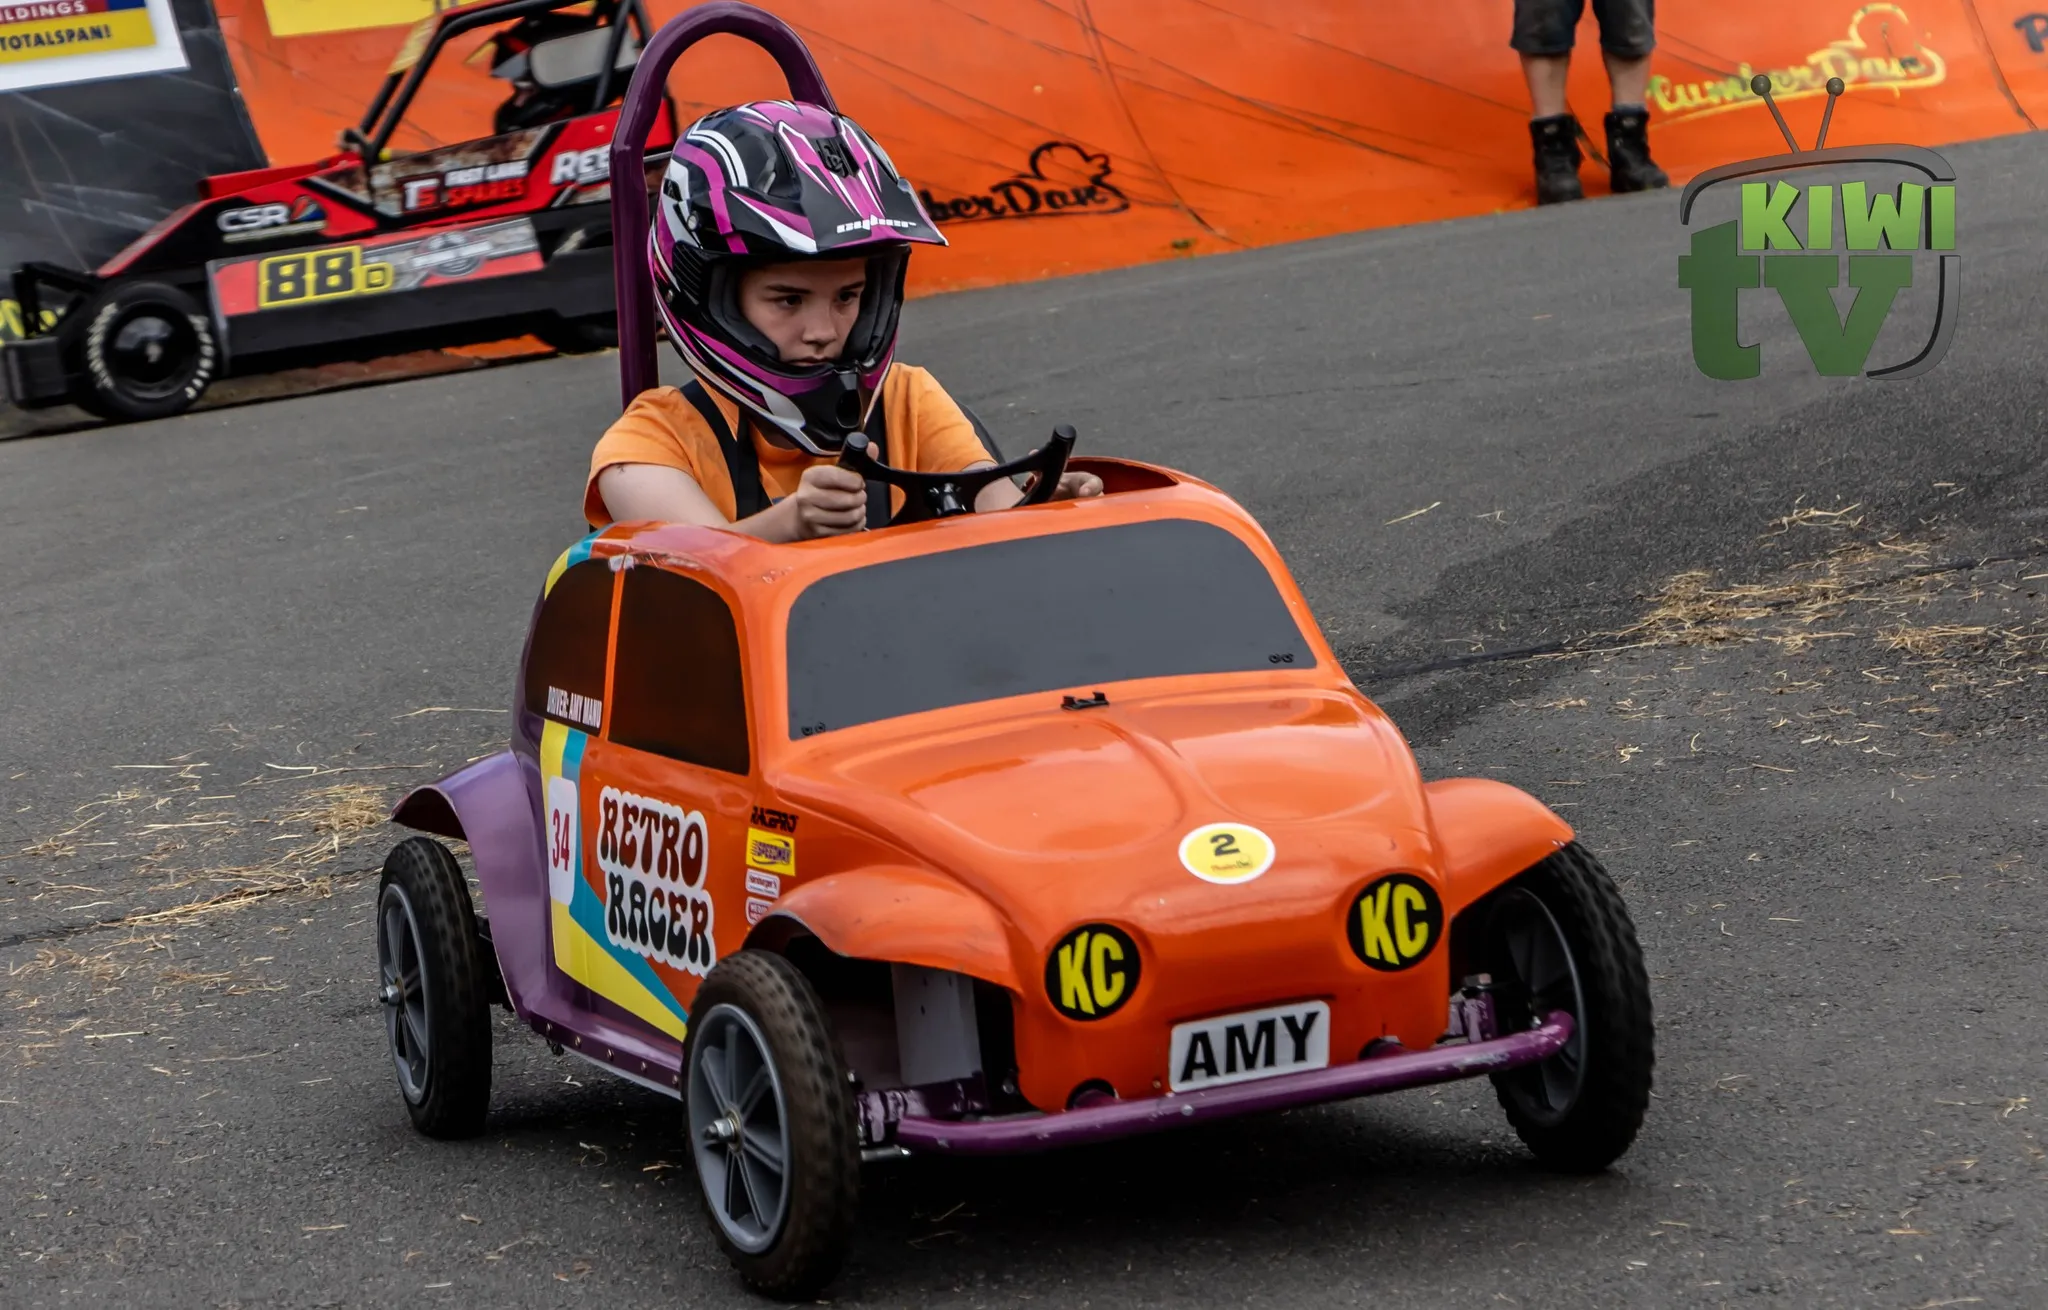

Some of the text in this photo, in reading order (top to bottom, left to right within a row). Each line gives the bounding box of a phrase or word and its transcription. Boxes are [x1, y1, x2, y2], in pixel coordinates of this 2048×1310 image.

[217, 203, 291, 233] CSR
[568, 692, 584, 723] AMY
[552, 808, 571, 872] 34
[600, 797, 703, 887] RETRO
[1209, 833, 1240, 857] 2
[608, 872, 711, 967] RACER
[1358, 881, 1430, 966] KC
[1058, 930, 1126, 1016] KC
[1179, 1010, 1321, 1083] AMY
